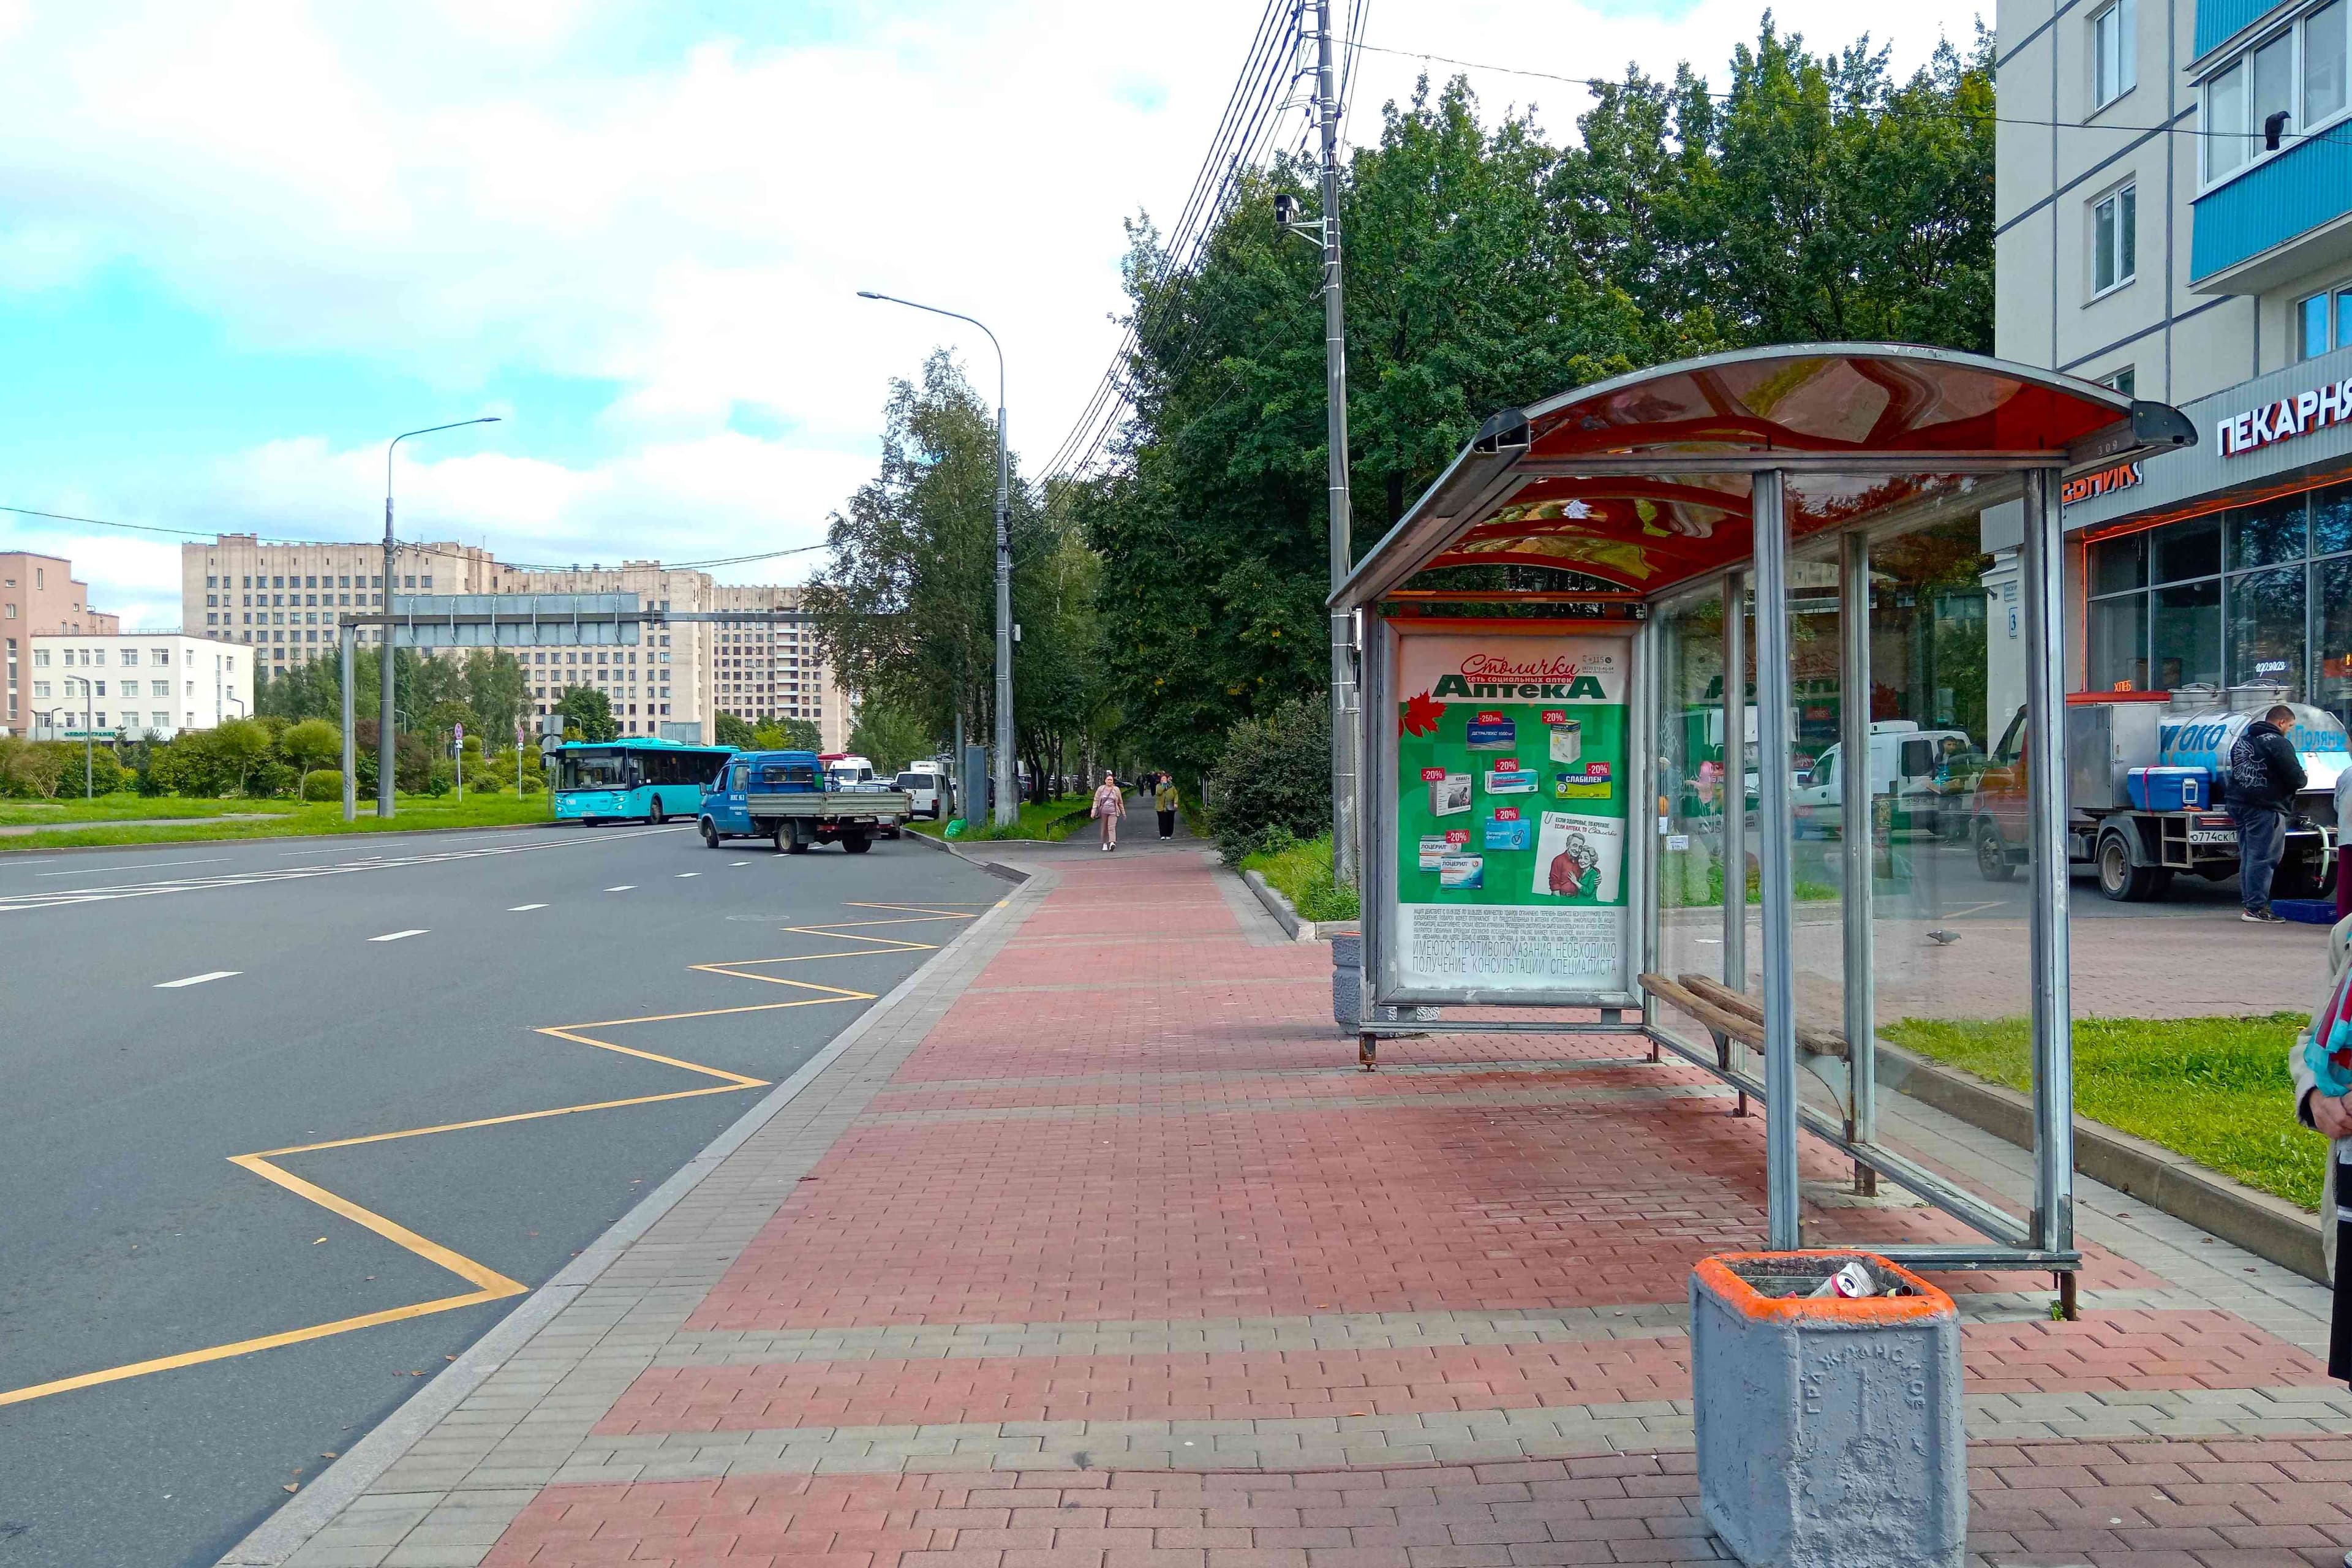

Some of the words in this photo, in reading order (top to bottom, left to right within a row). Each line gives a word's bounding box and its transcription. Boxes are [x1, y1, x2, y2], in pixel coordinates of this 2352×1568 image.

[2098, 440, 2118, 456] 309
[1461, 654, 1580, 675] Столички
[1432, 674, 1607, 699] АптекА
[1544, 712, 1563, 722] -20%
[1496, 761, 1517, 771] -20%
[1588, 764, 1608, 774] -20%
[1423, 770, 1443, 780] -20%
[1497, 810, 1517, 820] -20%
[1447, 832, 1467, 842] -20%
[1413, 940, 1455, 956] ИМЕЮТСЯ
[1458, 941, 1551, 958] ПРОТИВОПОКАЗАНИЯ
[1556, 943, 1617, 959] НЕОБХОДИМО
[1413, 956, 1466, 973] ПОЛУЧЕНИЕ
[1472, 957, 1545, 975] КОНСУЛЬТАЦИИ
[1550, 959, 1616, 976] СПЕЦИАЛИСТА
